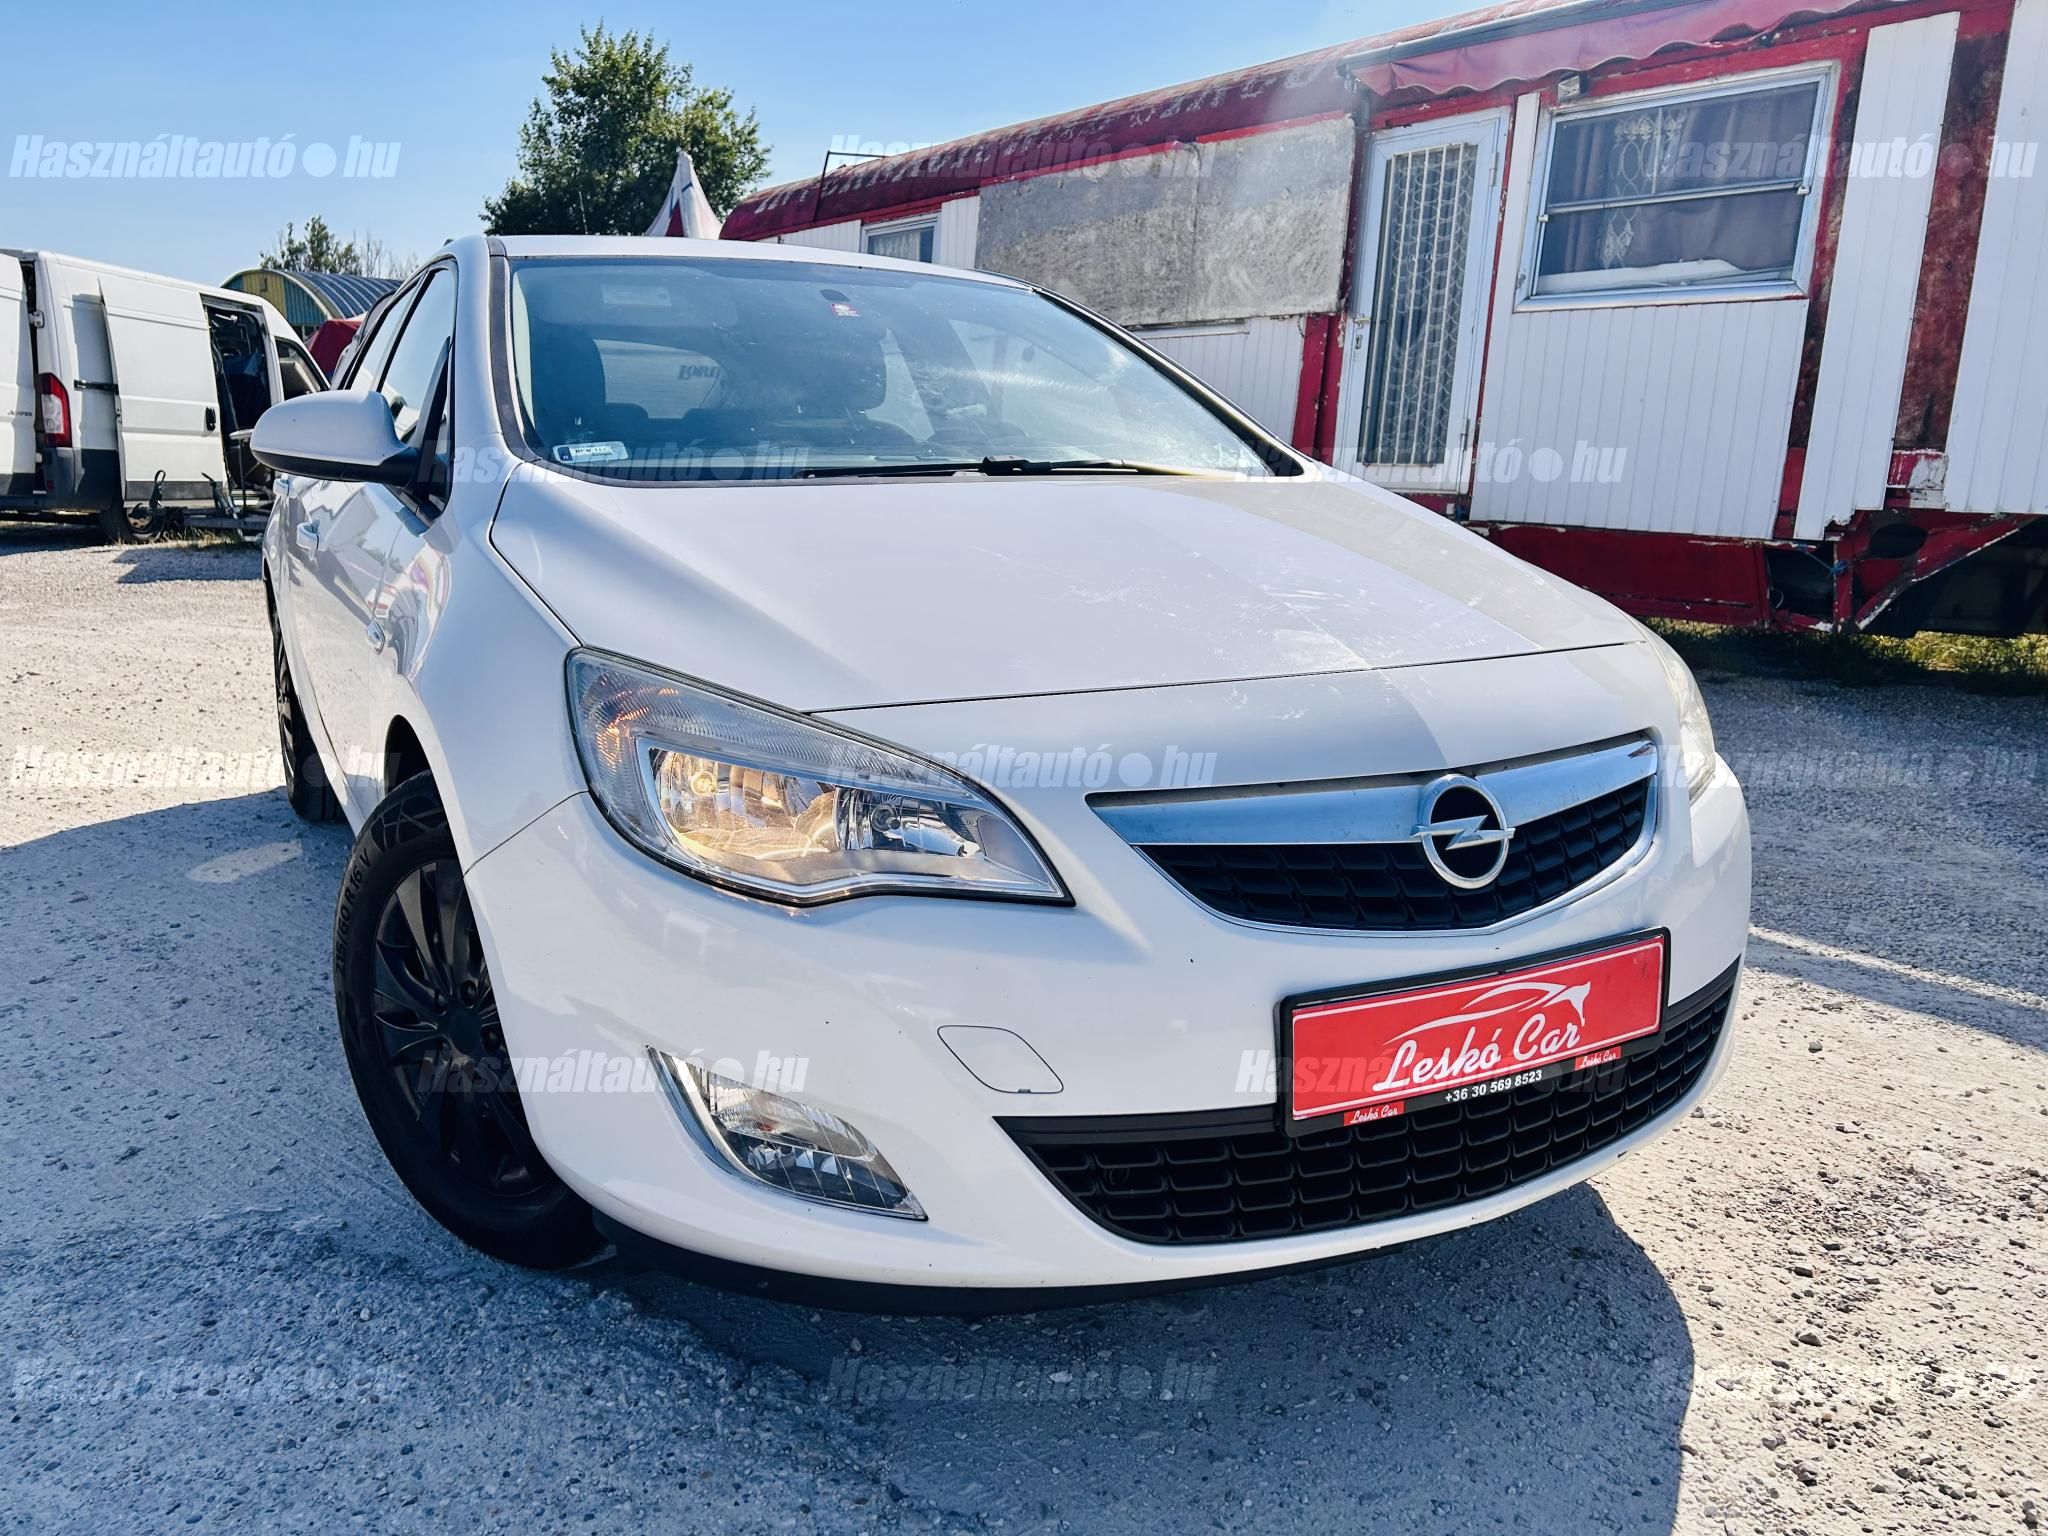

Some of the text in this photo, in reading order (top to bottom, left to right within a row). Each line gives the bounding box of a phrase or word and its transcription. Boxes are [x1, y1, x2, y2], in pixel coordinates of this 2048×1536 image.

[1373, 1013, 1581, 1092] Leskó Car
[1445, 1069, 1543, 1102] +36 30 569 8523
[1380, 1104, 1399, 1118] Car
